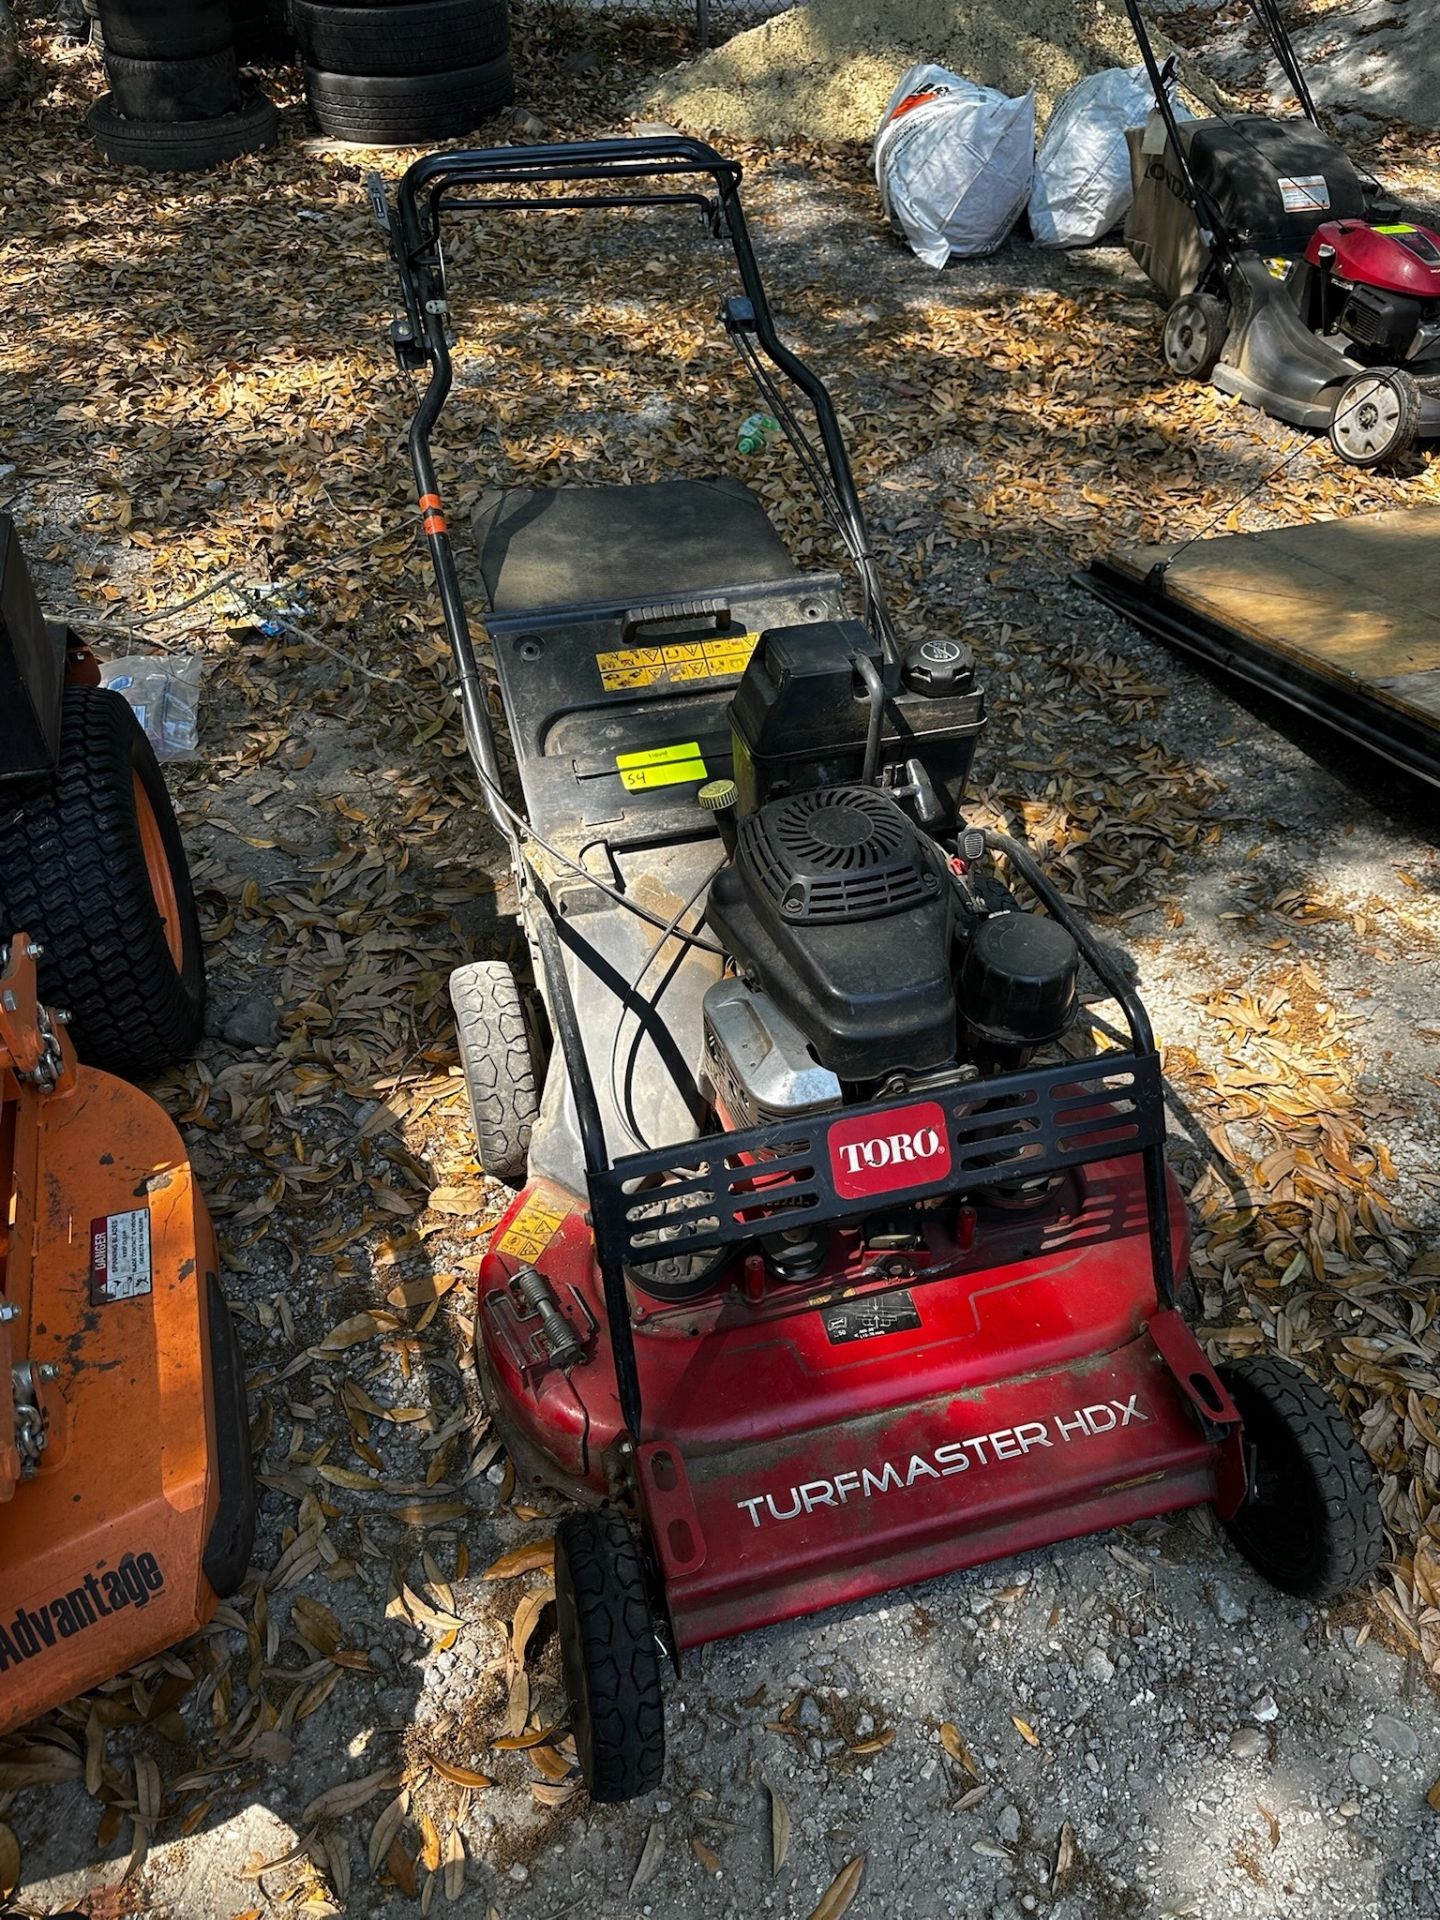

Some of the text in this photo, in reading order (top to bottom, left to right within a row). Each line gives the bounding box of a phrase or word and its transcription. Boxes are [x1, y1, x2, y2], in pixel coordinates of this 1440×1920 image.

[95, 1232, 106, 1270] DANGER
[736, 1394, 1149, 1528] TURFMASTER HDX
